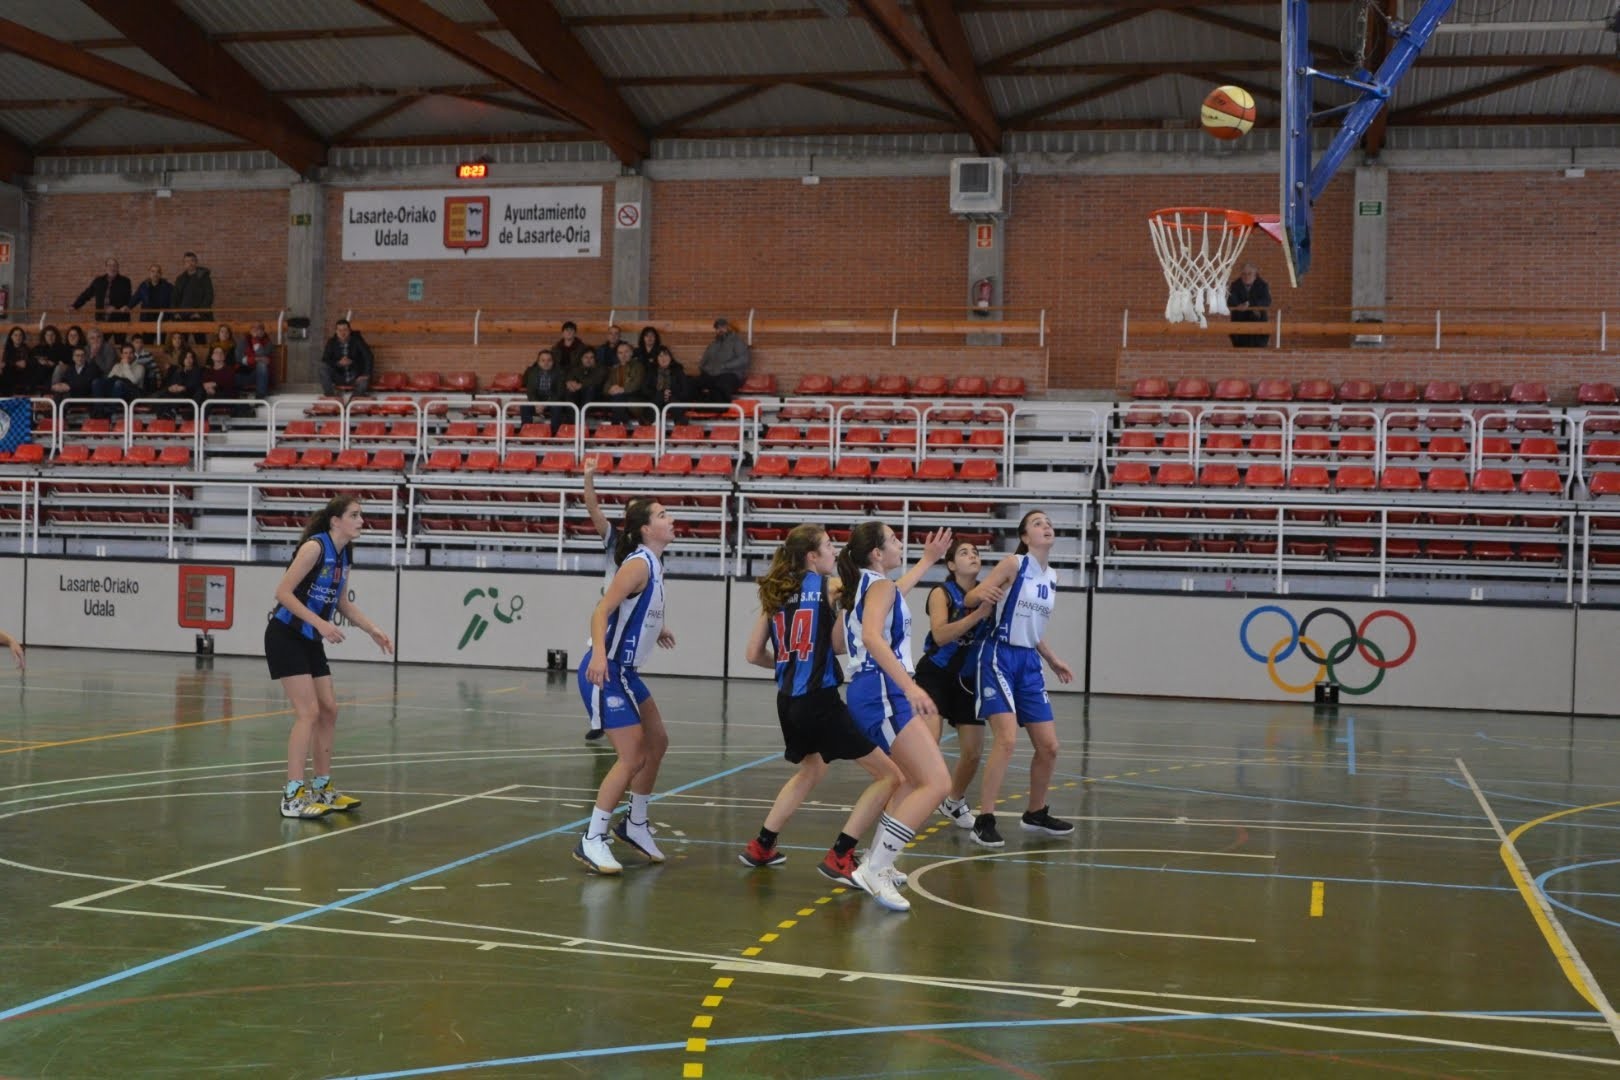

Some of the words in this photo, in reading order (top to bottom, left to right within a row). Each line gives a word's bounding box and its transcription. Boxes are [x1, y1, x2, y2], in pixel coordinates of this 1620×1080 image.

[460, 165, 485, 177] 10:23
[349, 205, 437, 224] Lasarte-Oriako
[504, 203, 586, 224] Ayuntamiento
[375, 229, 409, 246] Udala
[499, 228, 513, 245] de
[517, 225, 591, 244] Lasarte-Oria
[59, 574, 139, 595] Lasarte-Oriako
[1036, 583, 1049, 600] 10
[84, 599, 115, 617] Udala
[773, 609, 813, 663] 14
